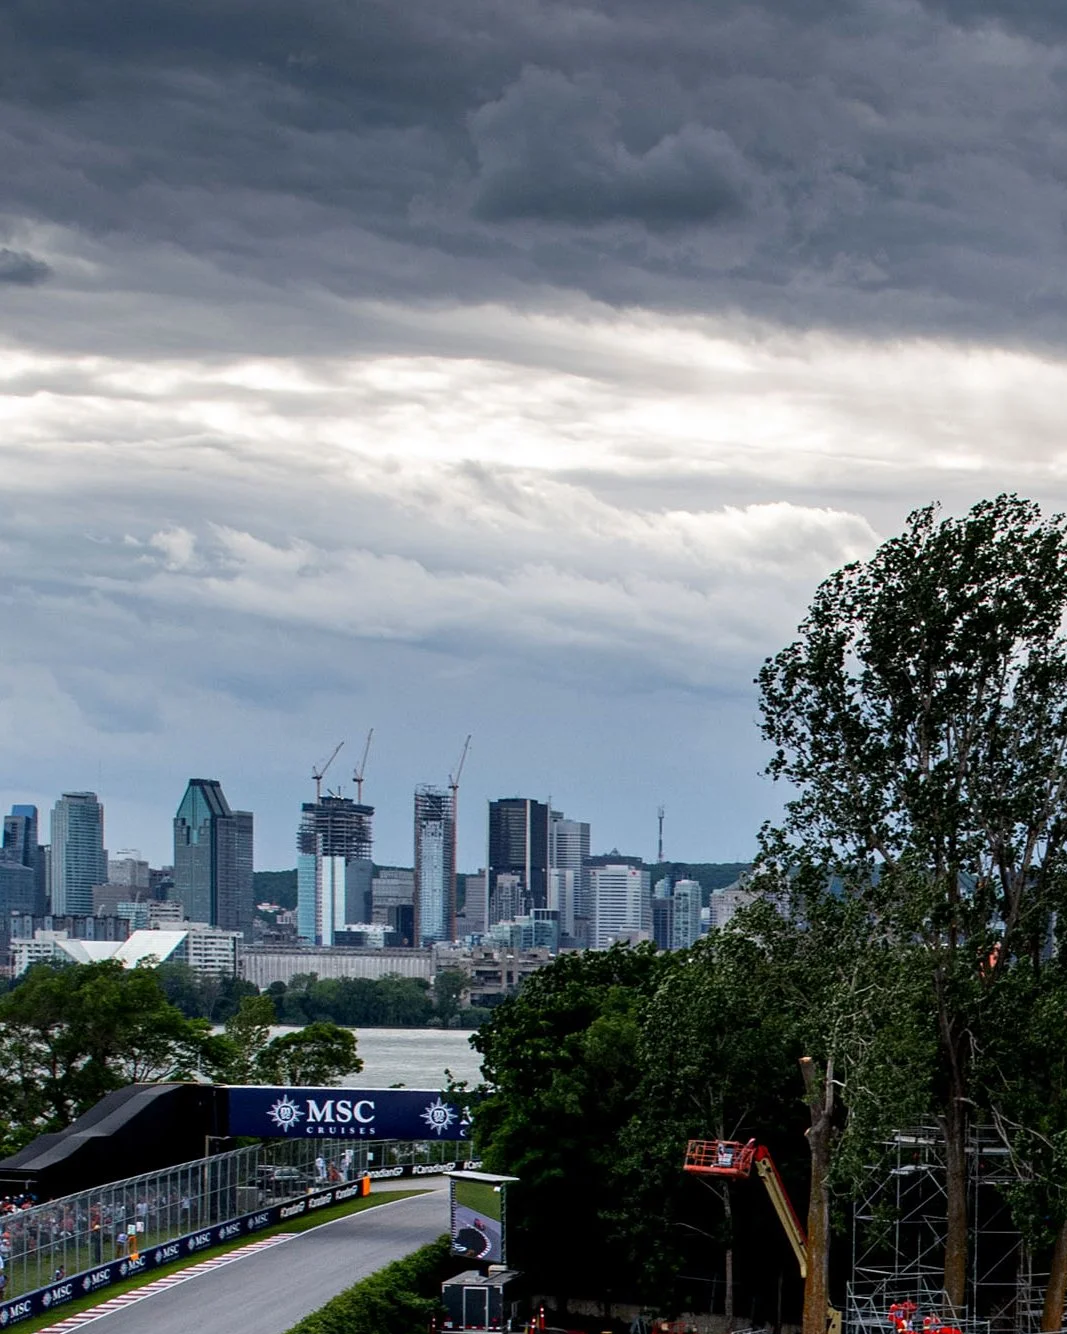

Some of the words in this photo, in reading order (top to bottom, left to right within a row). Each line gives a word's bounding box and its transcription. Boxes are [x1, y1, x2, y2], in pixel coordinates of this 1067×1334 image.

[306, 1100, 375, 1123] MSC
[412, 1162, 456, 1175] #CanadianGP
[195, 1232, 211, 1246] MSC
[163, 1244, 179, 1258] MSC
[91, 1269, 110, 1285] MSC
[52, 1284, 72, 1300] MSC
[10, 1300, 31, 1318] MSC
